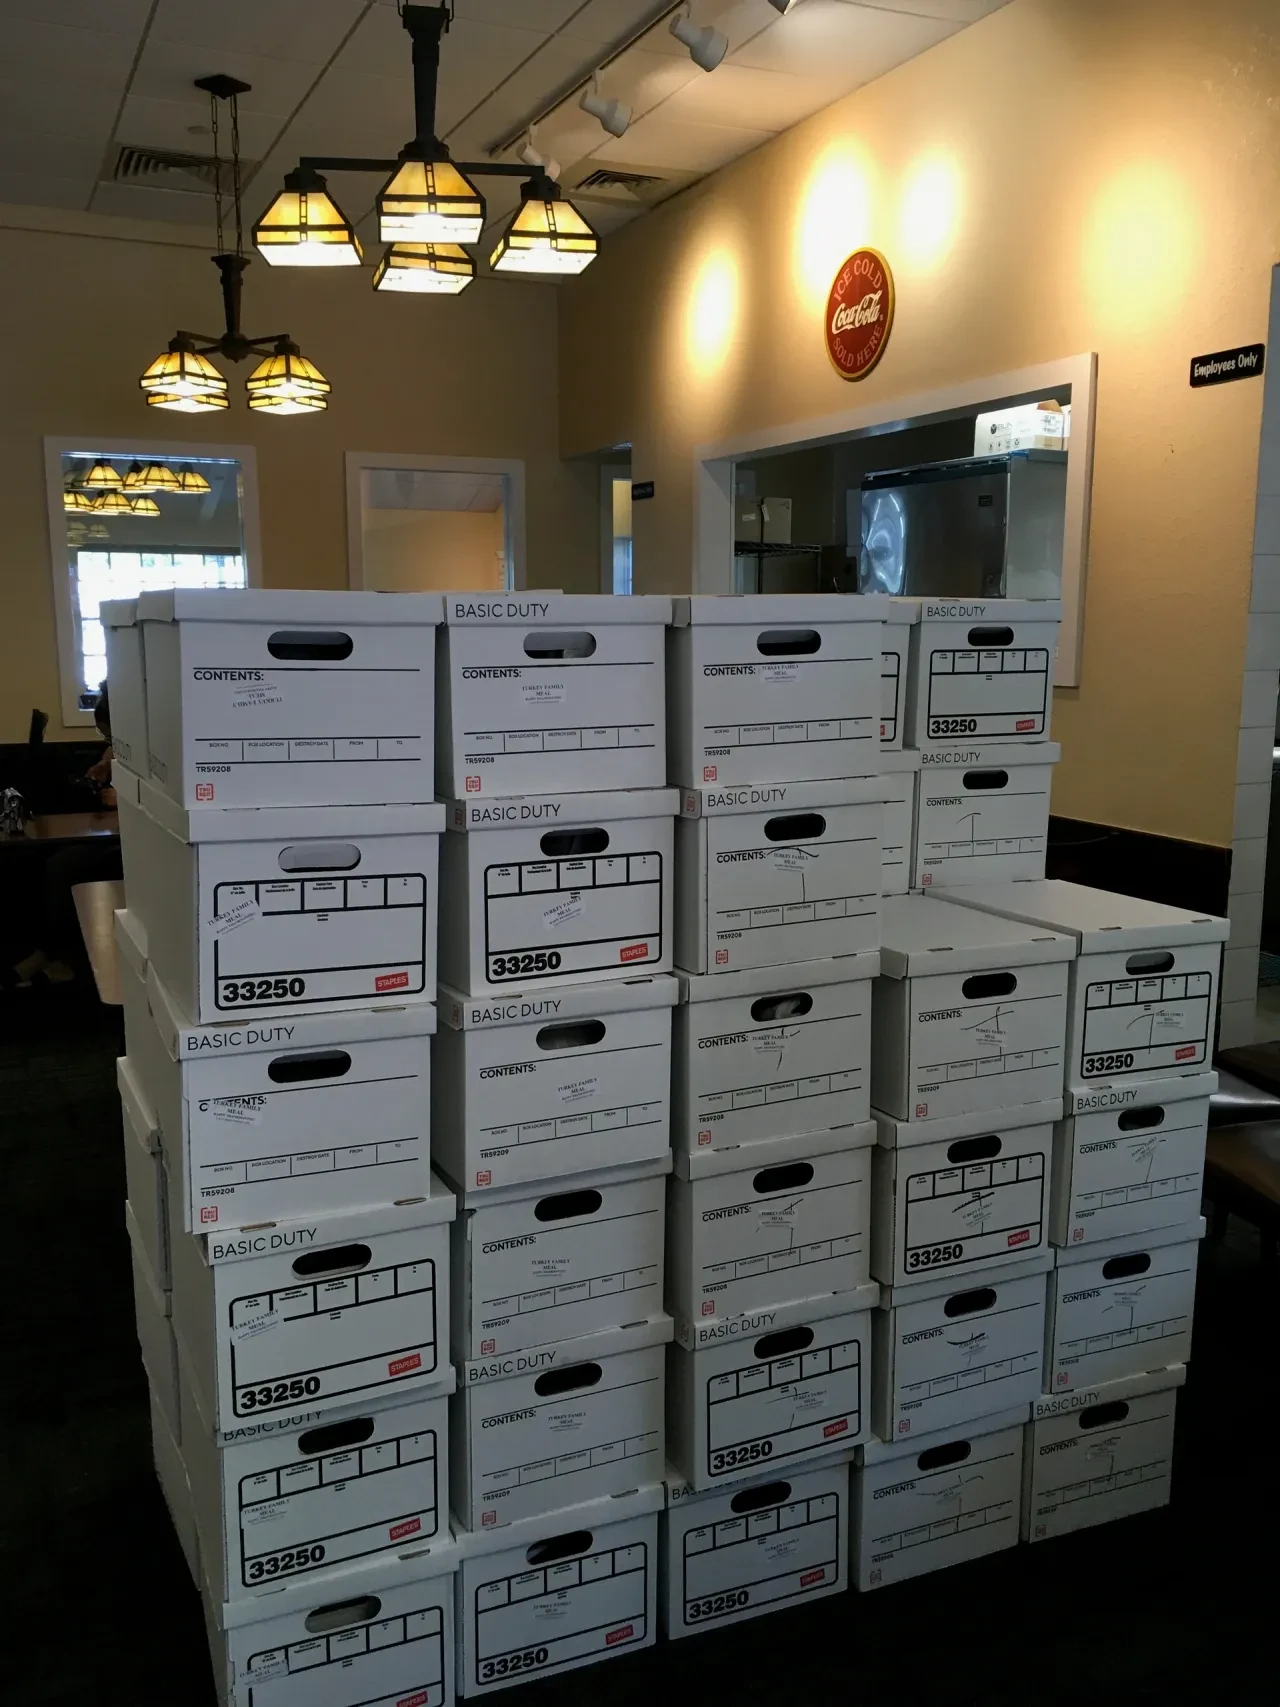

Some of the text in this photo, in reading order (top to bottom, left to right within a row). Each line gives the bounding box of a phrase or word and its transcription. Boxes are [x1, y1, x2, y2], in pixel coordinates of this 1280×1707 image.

[834, 259, 882, 301] ICE COLD
[832, 290, 882, 334] Coca-Cola
[833, 324, 882, 366] SOLD HERE
[1194, 352, 1258, 378] Employees Only
[455, 604, 549, 618] BASIC DUTY
[928, 606, 985, 617] BASIC DUTY
[194, 670, 264, 681] CONTENTS:
[463, 669, 522, 679] CONTENTS:
[704, 667, 755, 676] CONTENTS:
[932, 719, 977, 734] 33250
[922, 752, 980, 764] BASIC DUTY
[708, 789, 786, 806] BASIC DUTY
[926, 798, 963, 806] CONTENTS:
[472, 804, 560, 822] BASIC DUTY
[717, 852, 766, 863] CONTENTS:
[207, 900, 254, 926] TURKEY FAMILY
[225, 913, 241, 923] MEAL
[622, 947, 646, 958] STAPLES
[492, 952, 561, 976] 33250
[223, 978, 305, 1002] 33250
[377, 975, 407, 988] STAPLES
[472, 1000, 561, 1023] BASIC DUTY
[919, 1010, 962, 1022] CONTENTS:
[188, 1027, 295, 1050] BASIC DUTY
[699, 1035, 748, 1049] CONTENTS:
[480, 1064, 536, 1079] CONTENTS:
[1086, 1053, 1133, 1073] 33250
[579, 1078, 598, 1086] FAMILY
[1077, 1091, 1137, 1110] BASIC DUTY
[480, 1149, 509, 1159] TR59209
[1080, 1142, 1118, 1154] CONTENTS:
[201, 1188, 235, 1197] TR59208
[702, 1206, 751, 1222] CONTENTS:
[213, 1228, 317, 1259] BASIC DUTY
[483, 1237, 536, 1254] CONTENTS:
[910, 1244, 963, 1268] 33250
[256, 1309, 279, 1322] FAMILY
[248, 1321, 266, 1331] MEAL
[482, 1319, 510, 1330] TR59209
[700, 1313, 776, 1342] BASIC DUTY
[902, 1329, 944, 1344] CONTENTS:
[391, 1358, 419, 1372] STAPLES
[470, 1351, 556, 1381] BASIC DUTY
[241, 1376, 320, 1409] 33250
[1037, 1392, 1100, 1415] BASIC DUTY
[224, 1411, 322, 1441] BASIC DUTY
[482, 1410, 536, 1428] CONTENTS:
[713, 1441, 772, 1470] 33250
[873, 1482, 916, 1500] CONTENTS:
[391, 1522, 419, 1537] STAPLES
[249, 1544, 325, 1579] 33250
[689, 1590, 748, 1618] 33250
[482, 1647, 548, 1678] 33250
